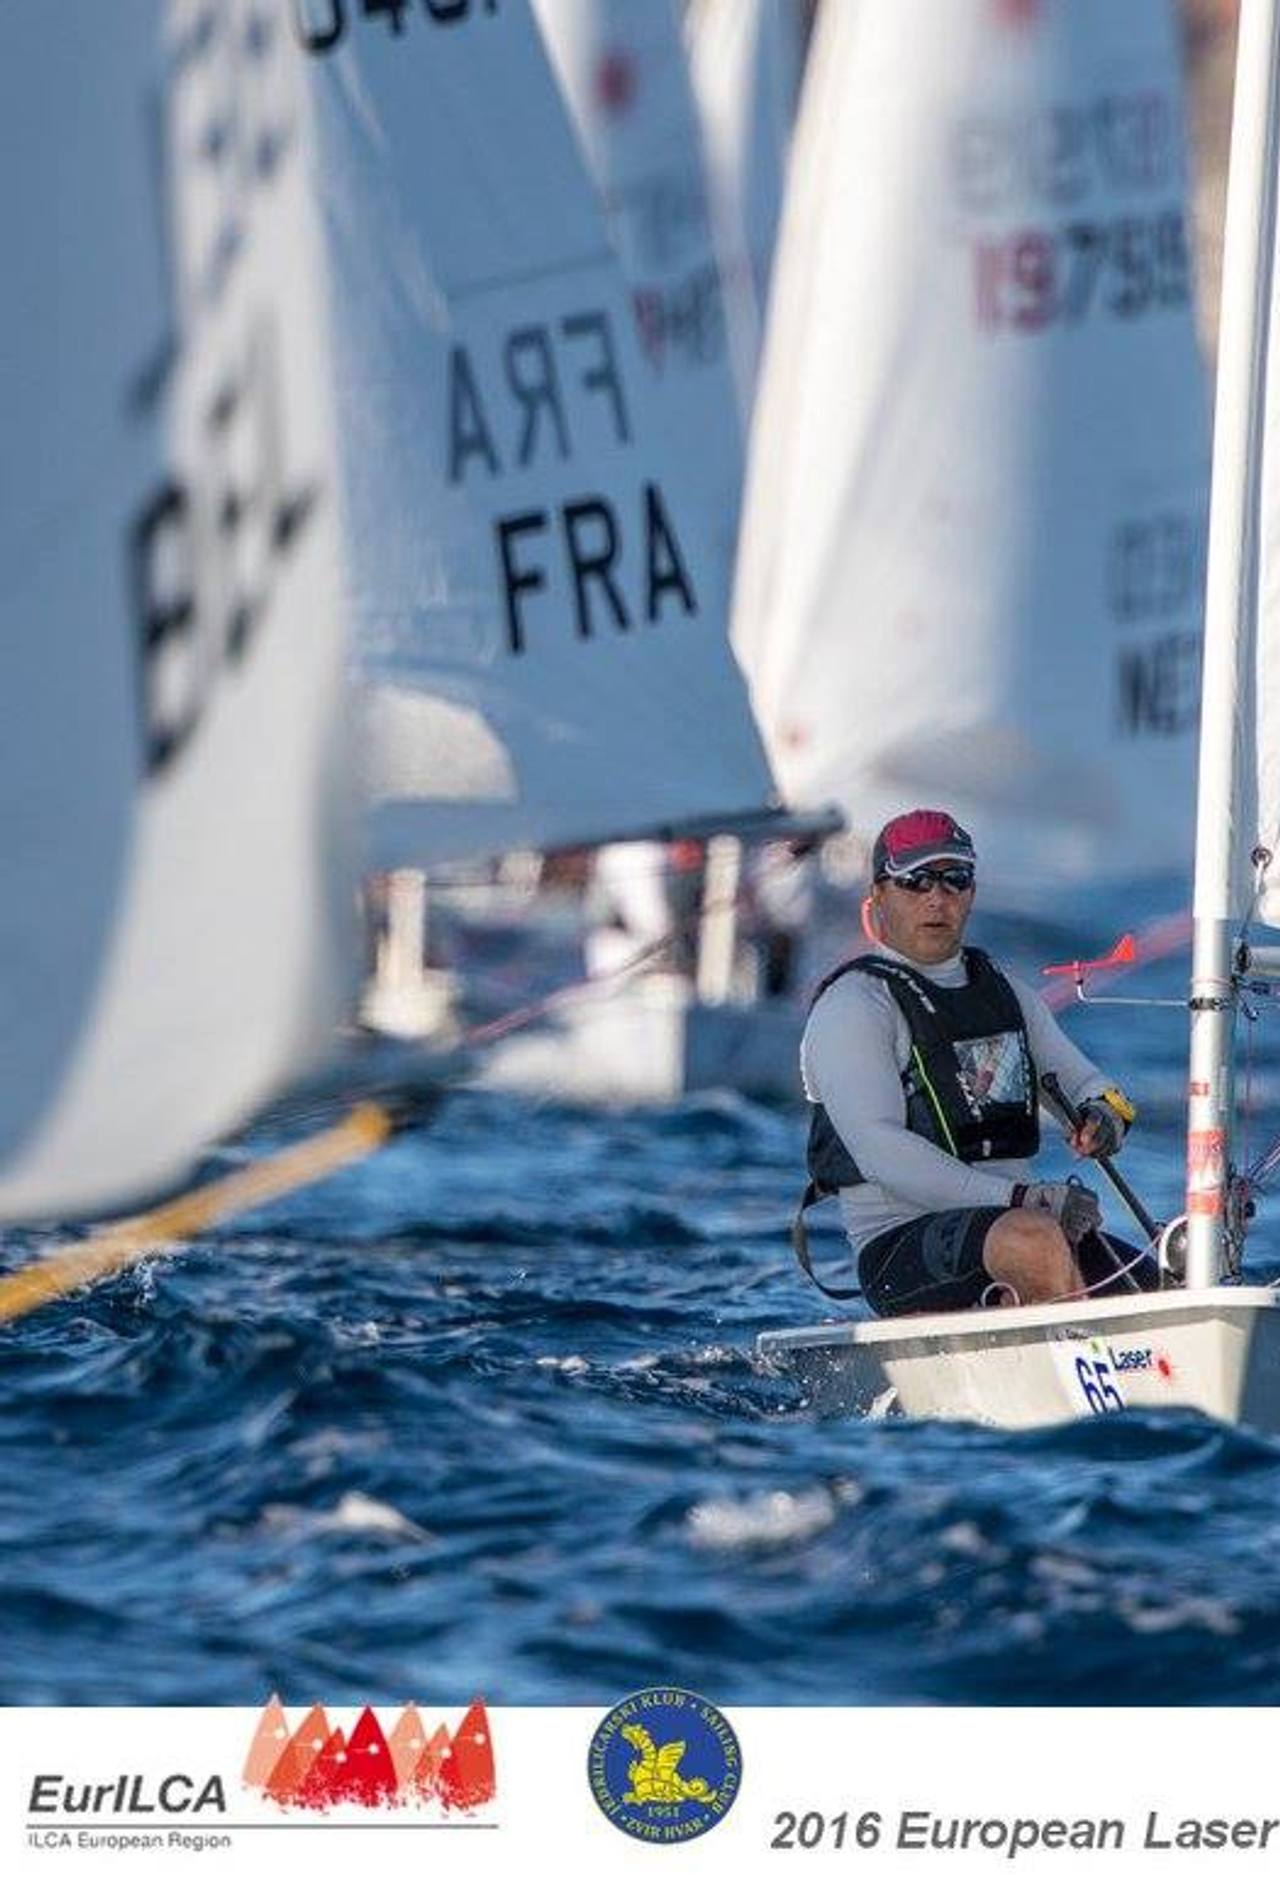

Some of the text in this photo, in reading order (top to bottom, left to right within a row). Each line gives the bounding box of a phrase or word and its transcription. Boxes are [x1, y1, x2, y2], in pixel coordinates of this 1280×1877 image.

[494, 478, 699, 656] FRA
[1075, 1356, 1127, 1416] 65
[1107, 1346, 1152, 1371] Laser
